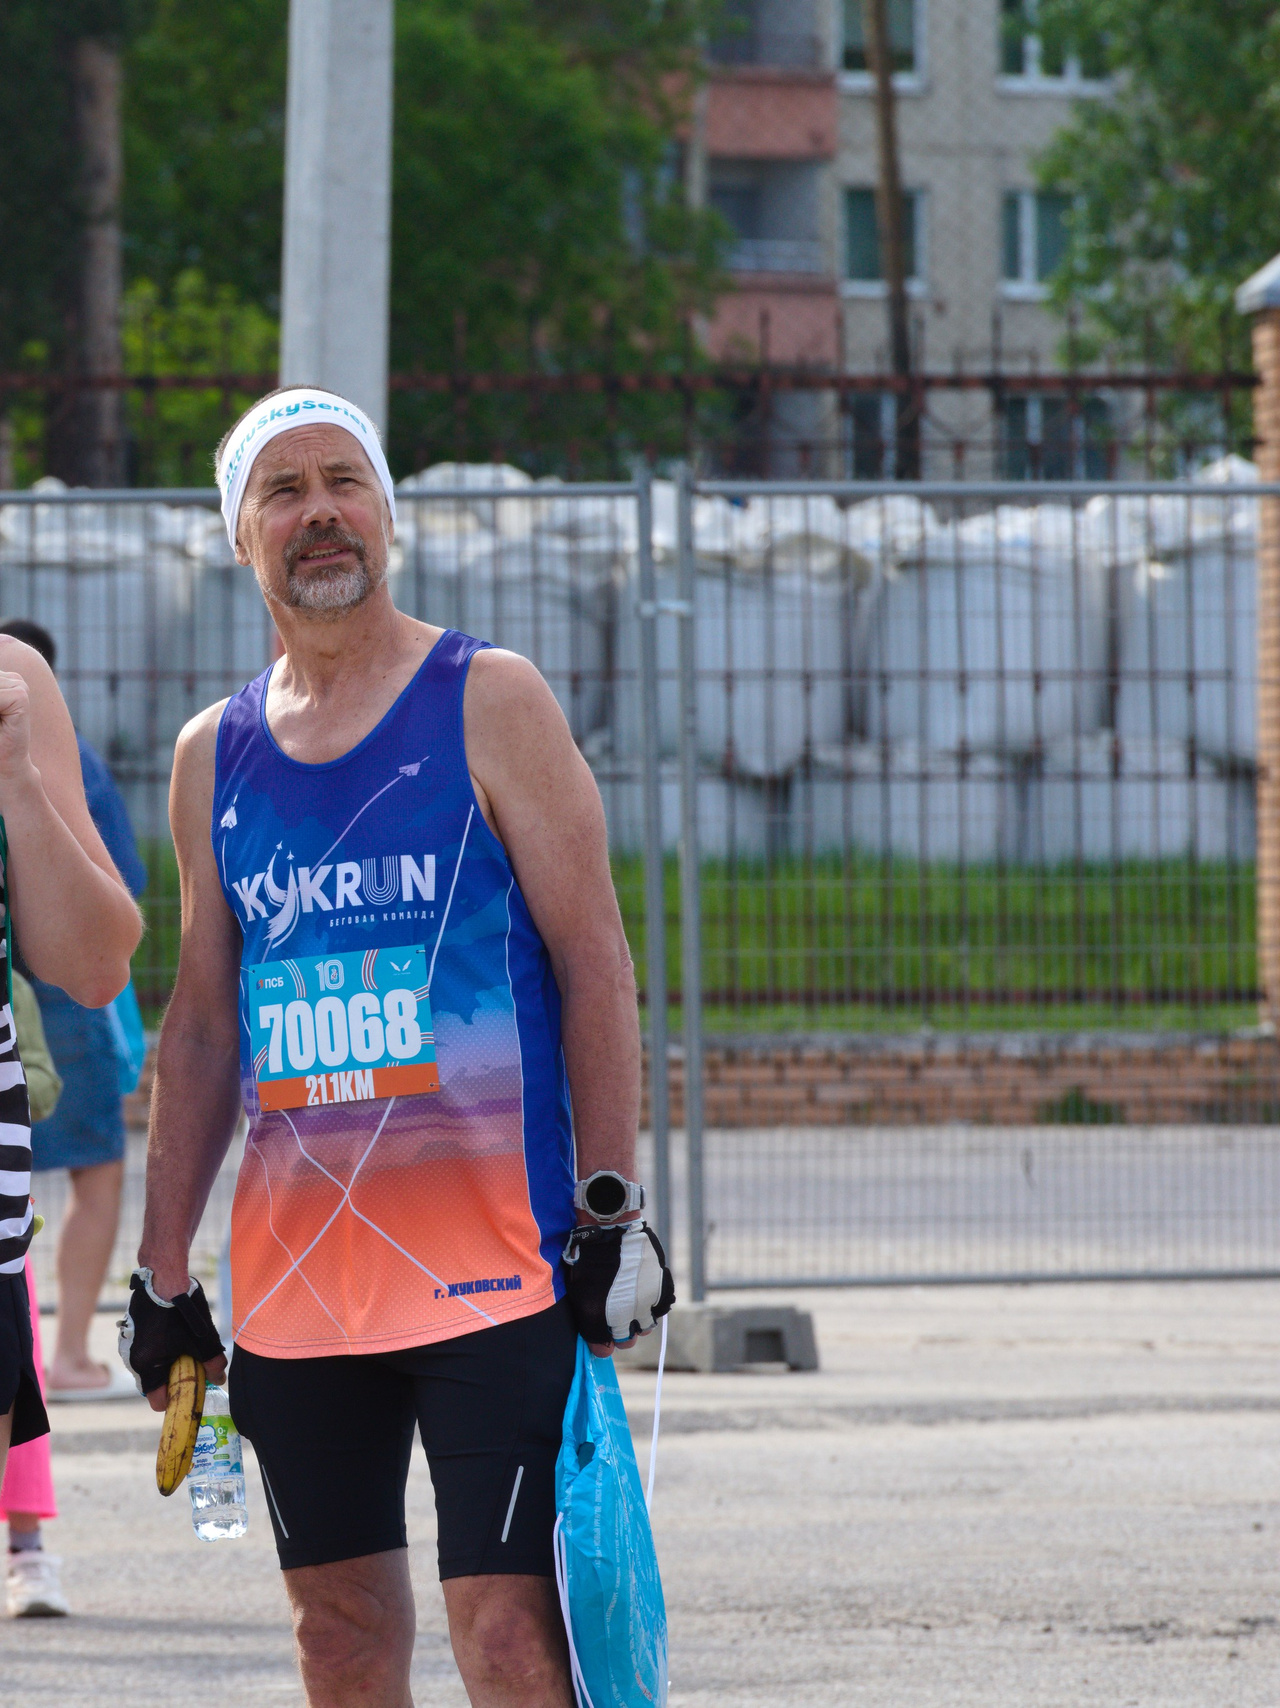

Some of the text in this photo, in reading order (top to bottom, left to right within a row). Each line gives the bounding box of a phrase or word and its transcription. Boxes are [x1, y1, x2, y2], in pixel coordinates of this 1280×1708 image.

[329, 910, 435, 927] БЕГОВАЯ КОМАНДА
[264, 976, 285, 989] ПСБ
[258, 988, 422, 1074] 70068
[447, 1274, 522, 1298] ЖУКОВСКИЙ
